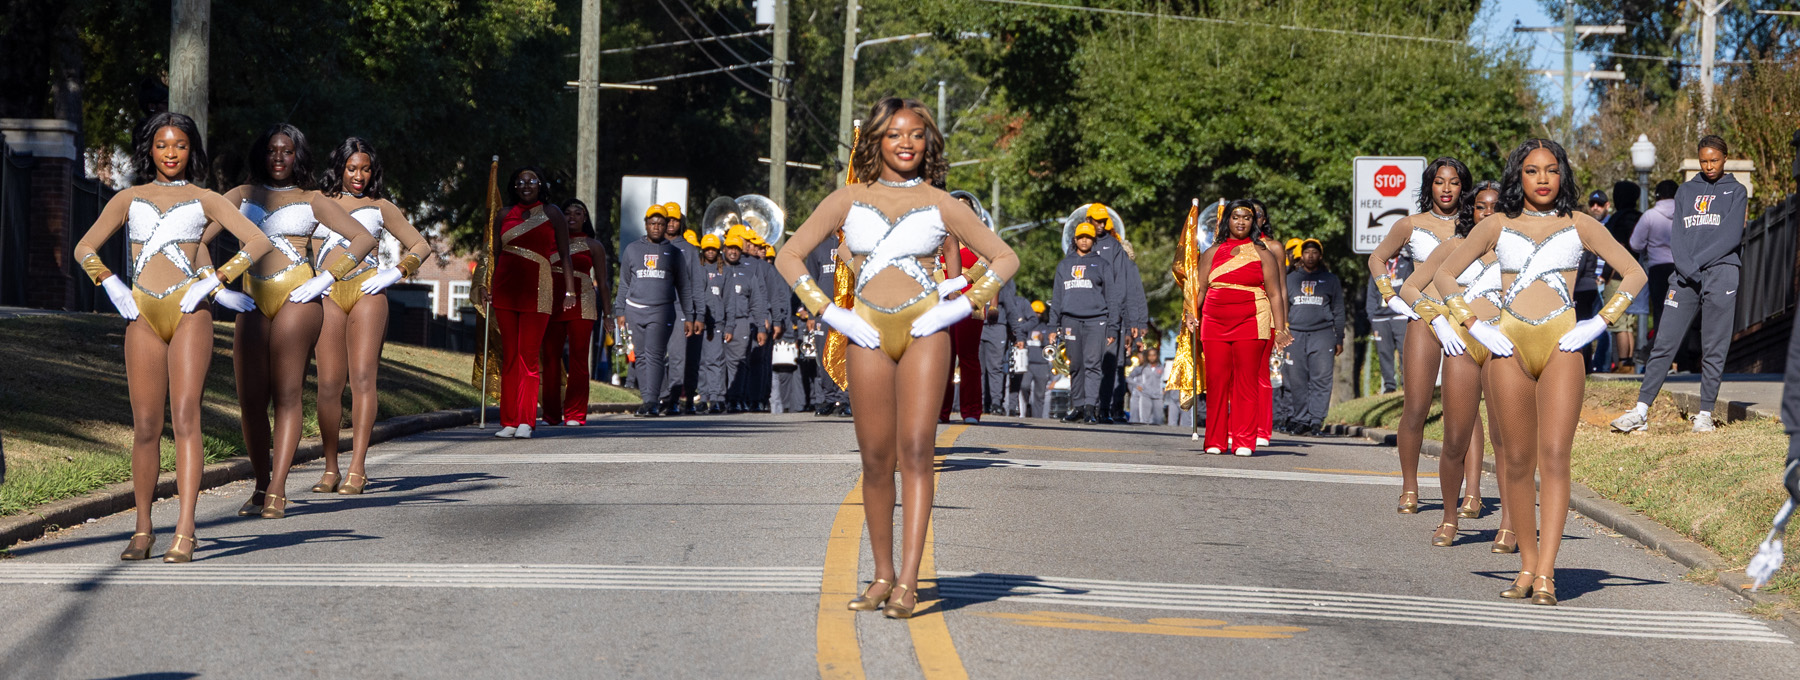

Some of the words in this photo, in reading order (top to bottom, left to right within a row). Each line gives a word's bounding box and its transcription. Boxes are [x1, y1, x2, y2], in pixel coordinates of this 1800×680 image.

[1375, 175, 1404, 188] STOP
[1360, 199, 1383, 208] HERE
[1692, 214, 1721, 226] STANDARD
[643, 269, 665, 279] STANDARD
[1069, 278, 1093, 288] STANDARD
